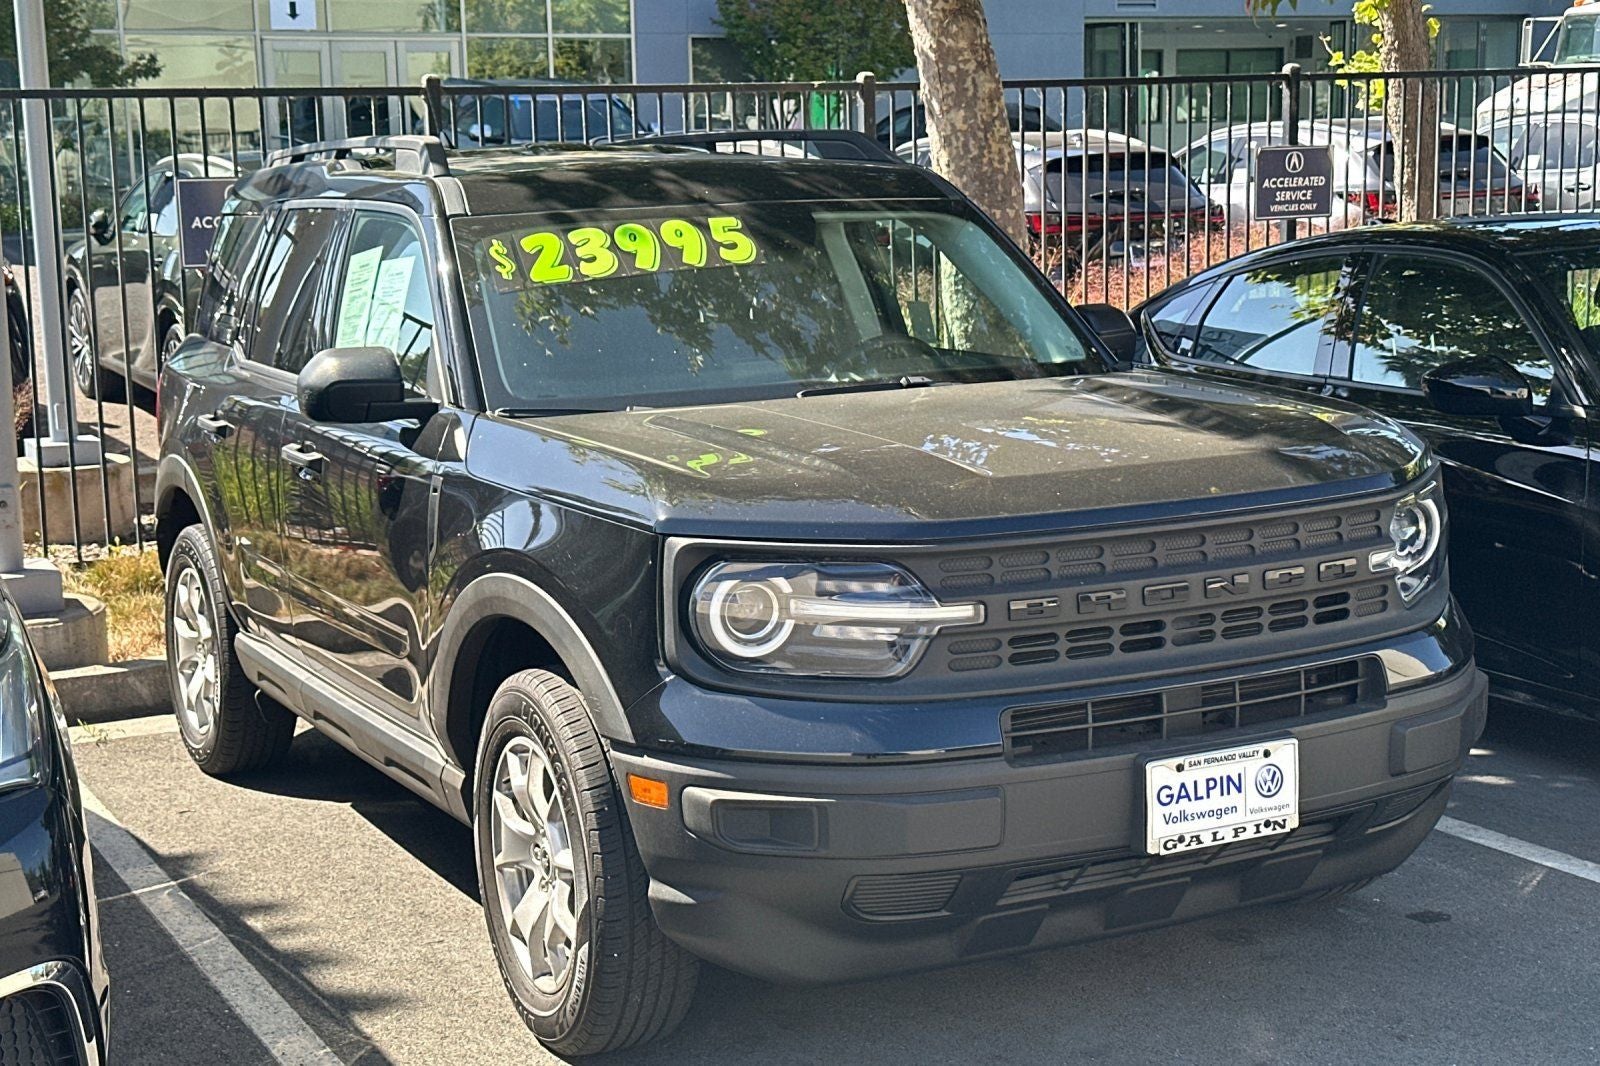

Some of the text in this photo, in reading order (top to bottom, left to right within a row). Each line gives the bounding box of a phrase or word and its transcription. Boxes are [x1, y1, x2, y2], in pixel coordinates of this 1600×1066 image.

[1262, 176, 1326, 188] ACCELERATED
[1275, 190, 1312, 201] SERVICE
[1270, 203, 1318, 212] VEHICLES ONLY
[1008, 557, 1358, 622] BRONCO
[1188, 749, 1261, 768] SAN FERNANDO VALLEY
[1156, 772, 1243, 807] GALPIN
[1162, 805, 1238, 825] Volkswagen
[1249, 802, 1290, 815] Volkswagen
[1163, 818, 1288, 852] GALPIN
